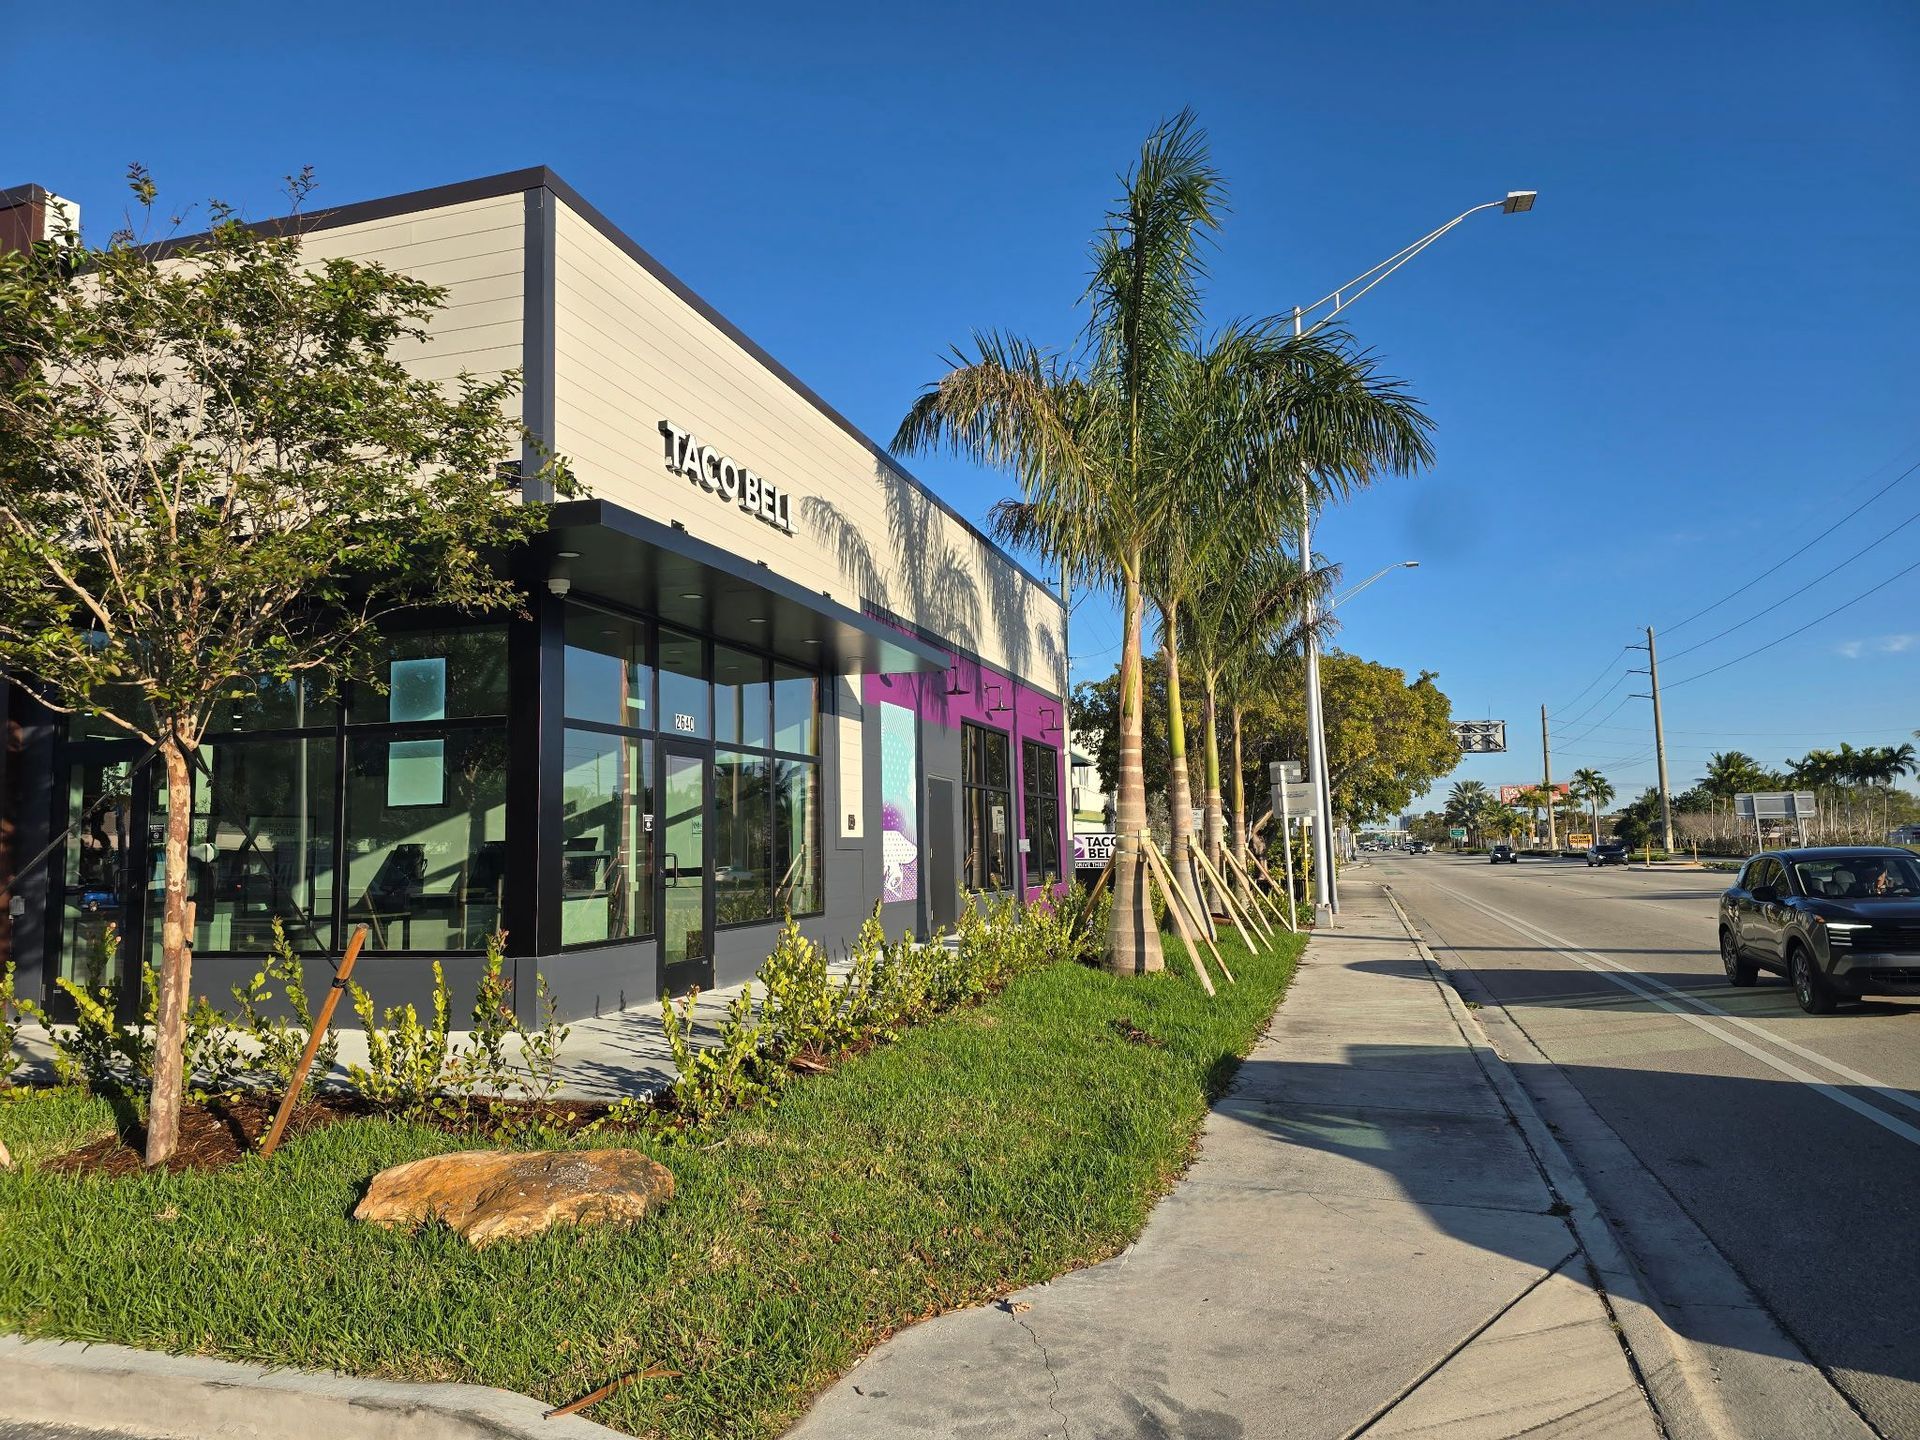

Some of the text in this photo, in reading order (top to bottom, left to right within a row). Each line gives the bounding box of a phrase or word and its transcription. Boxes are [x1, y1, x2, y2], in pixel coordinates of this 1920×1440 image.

[659, 420, 799, 535] TACO BELL
[1088, 848, 1111, 858] BEL
